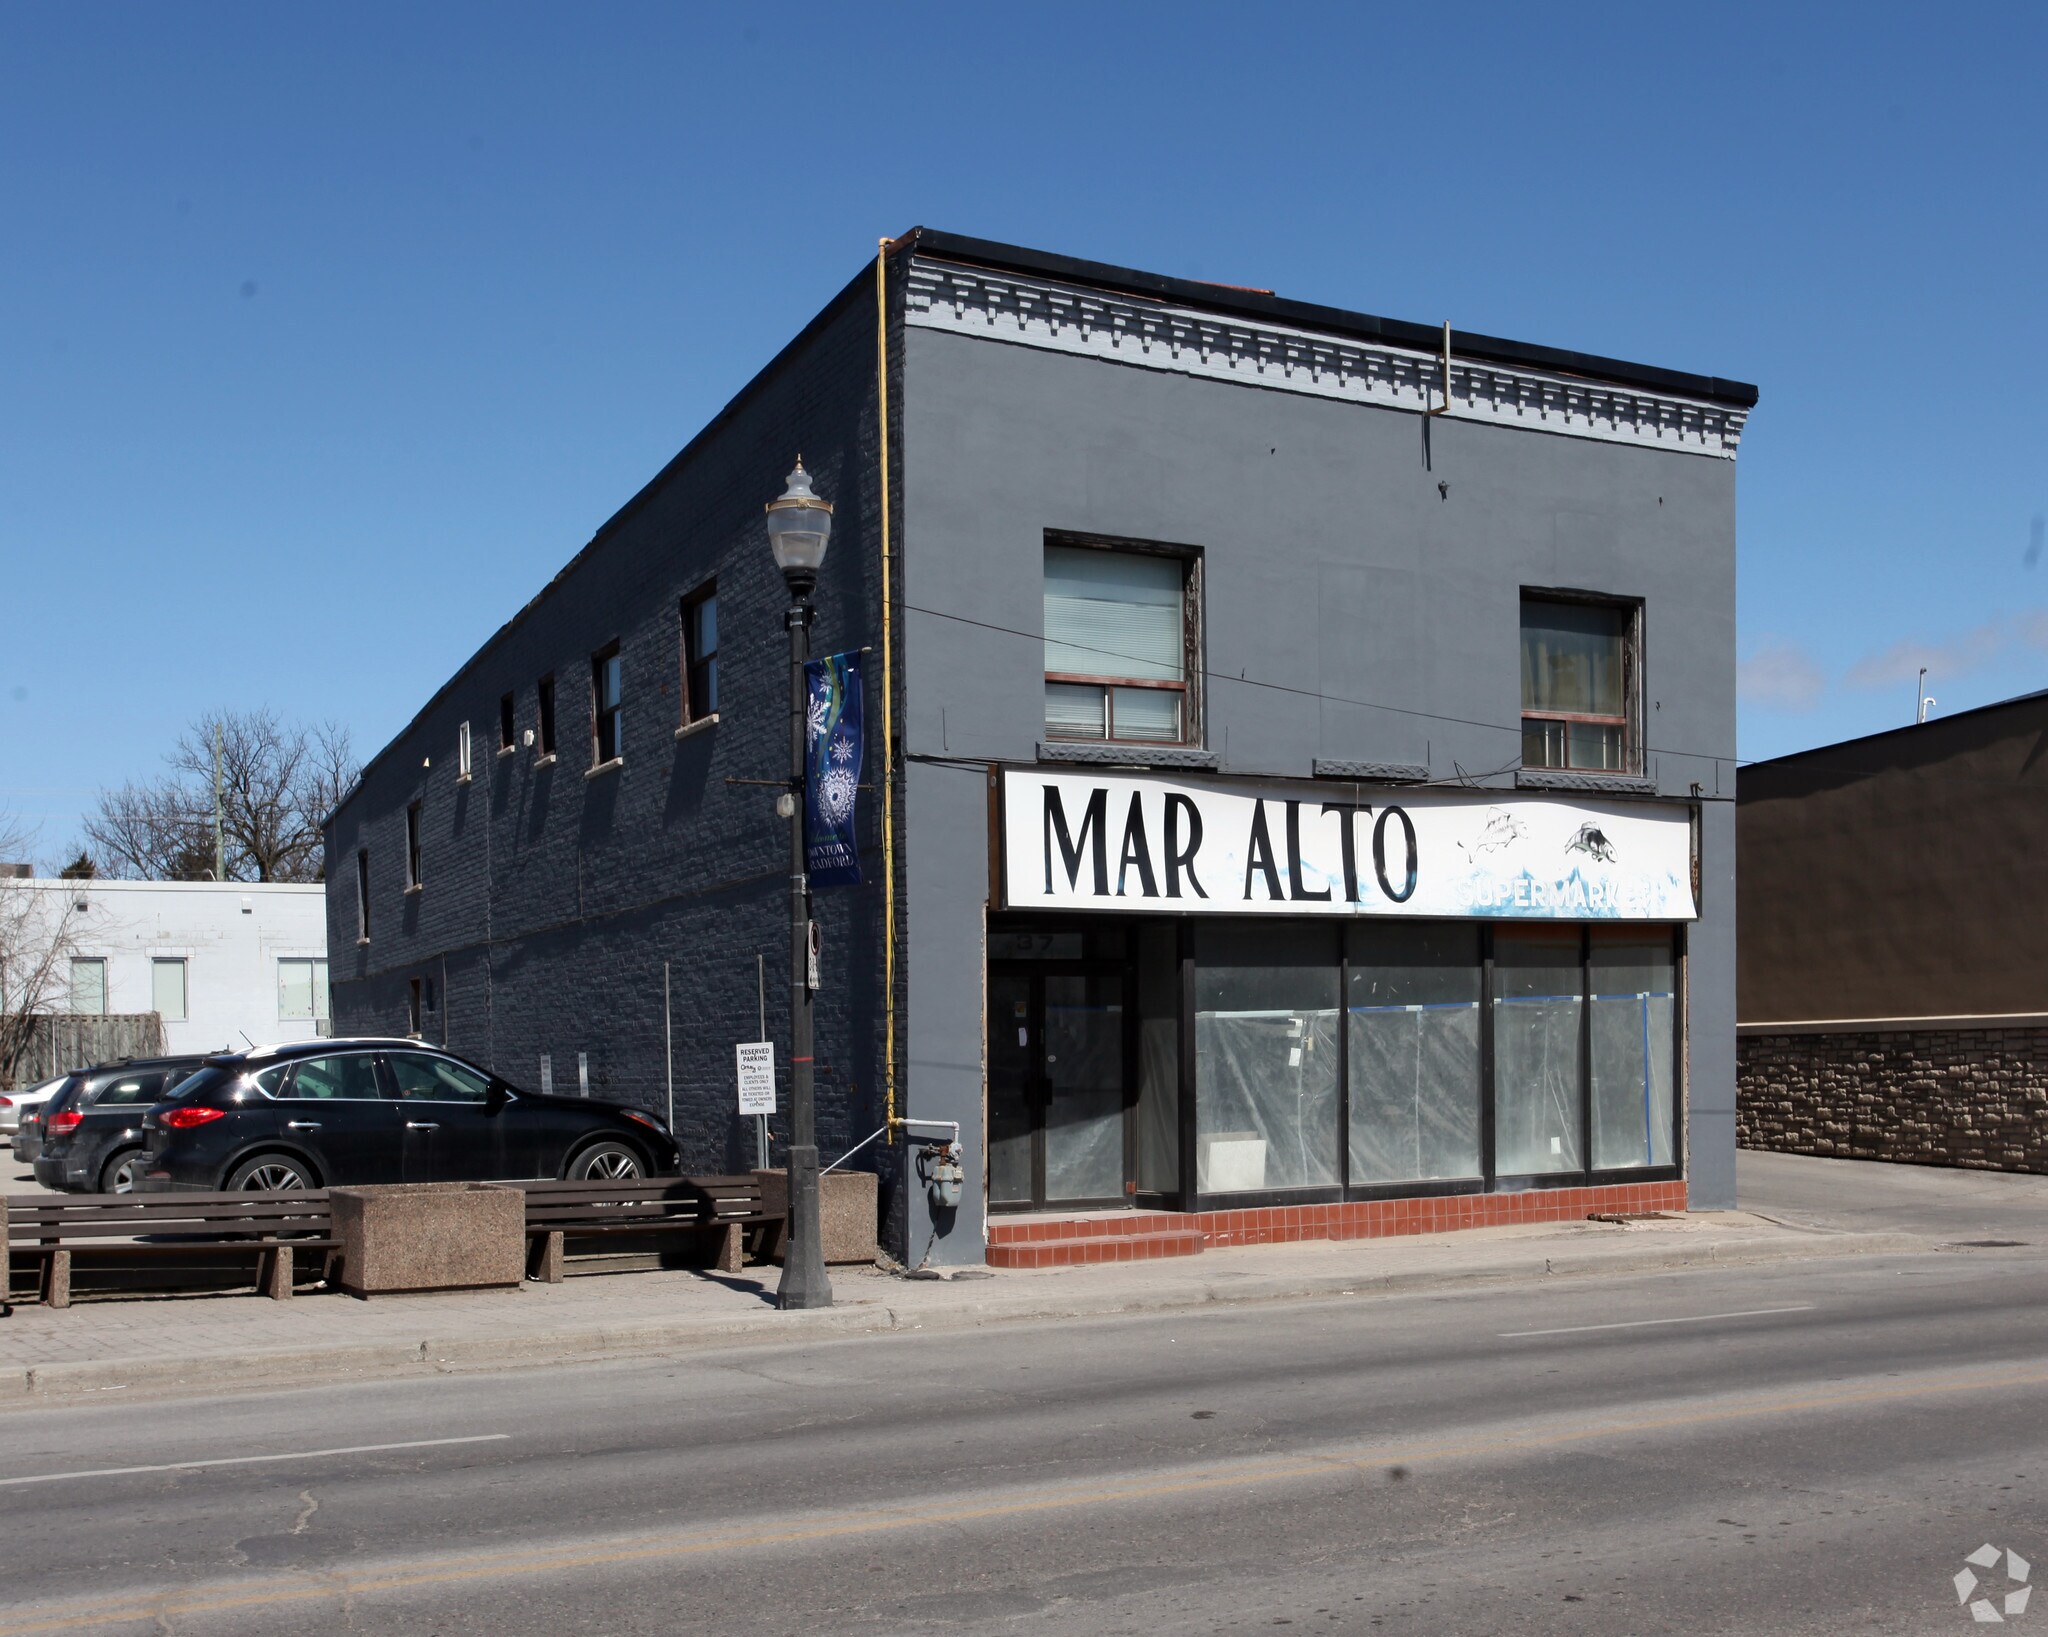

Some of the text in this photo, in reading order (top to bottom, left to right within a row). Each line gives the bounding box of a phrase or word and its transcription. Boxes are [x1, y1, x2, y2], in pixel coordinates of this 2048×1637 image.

[808, 843, 852, 857] OWNTOWN
[1042, 785, 1419, 904] MAR ALTO
[810, 855, 854, 870] RADFORD
[1457, 877, 1650, 911] SUPERMARK
